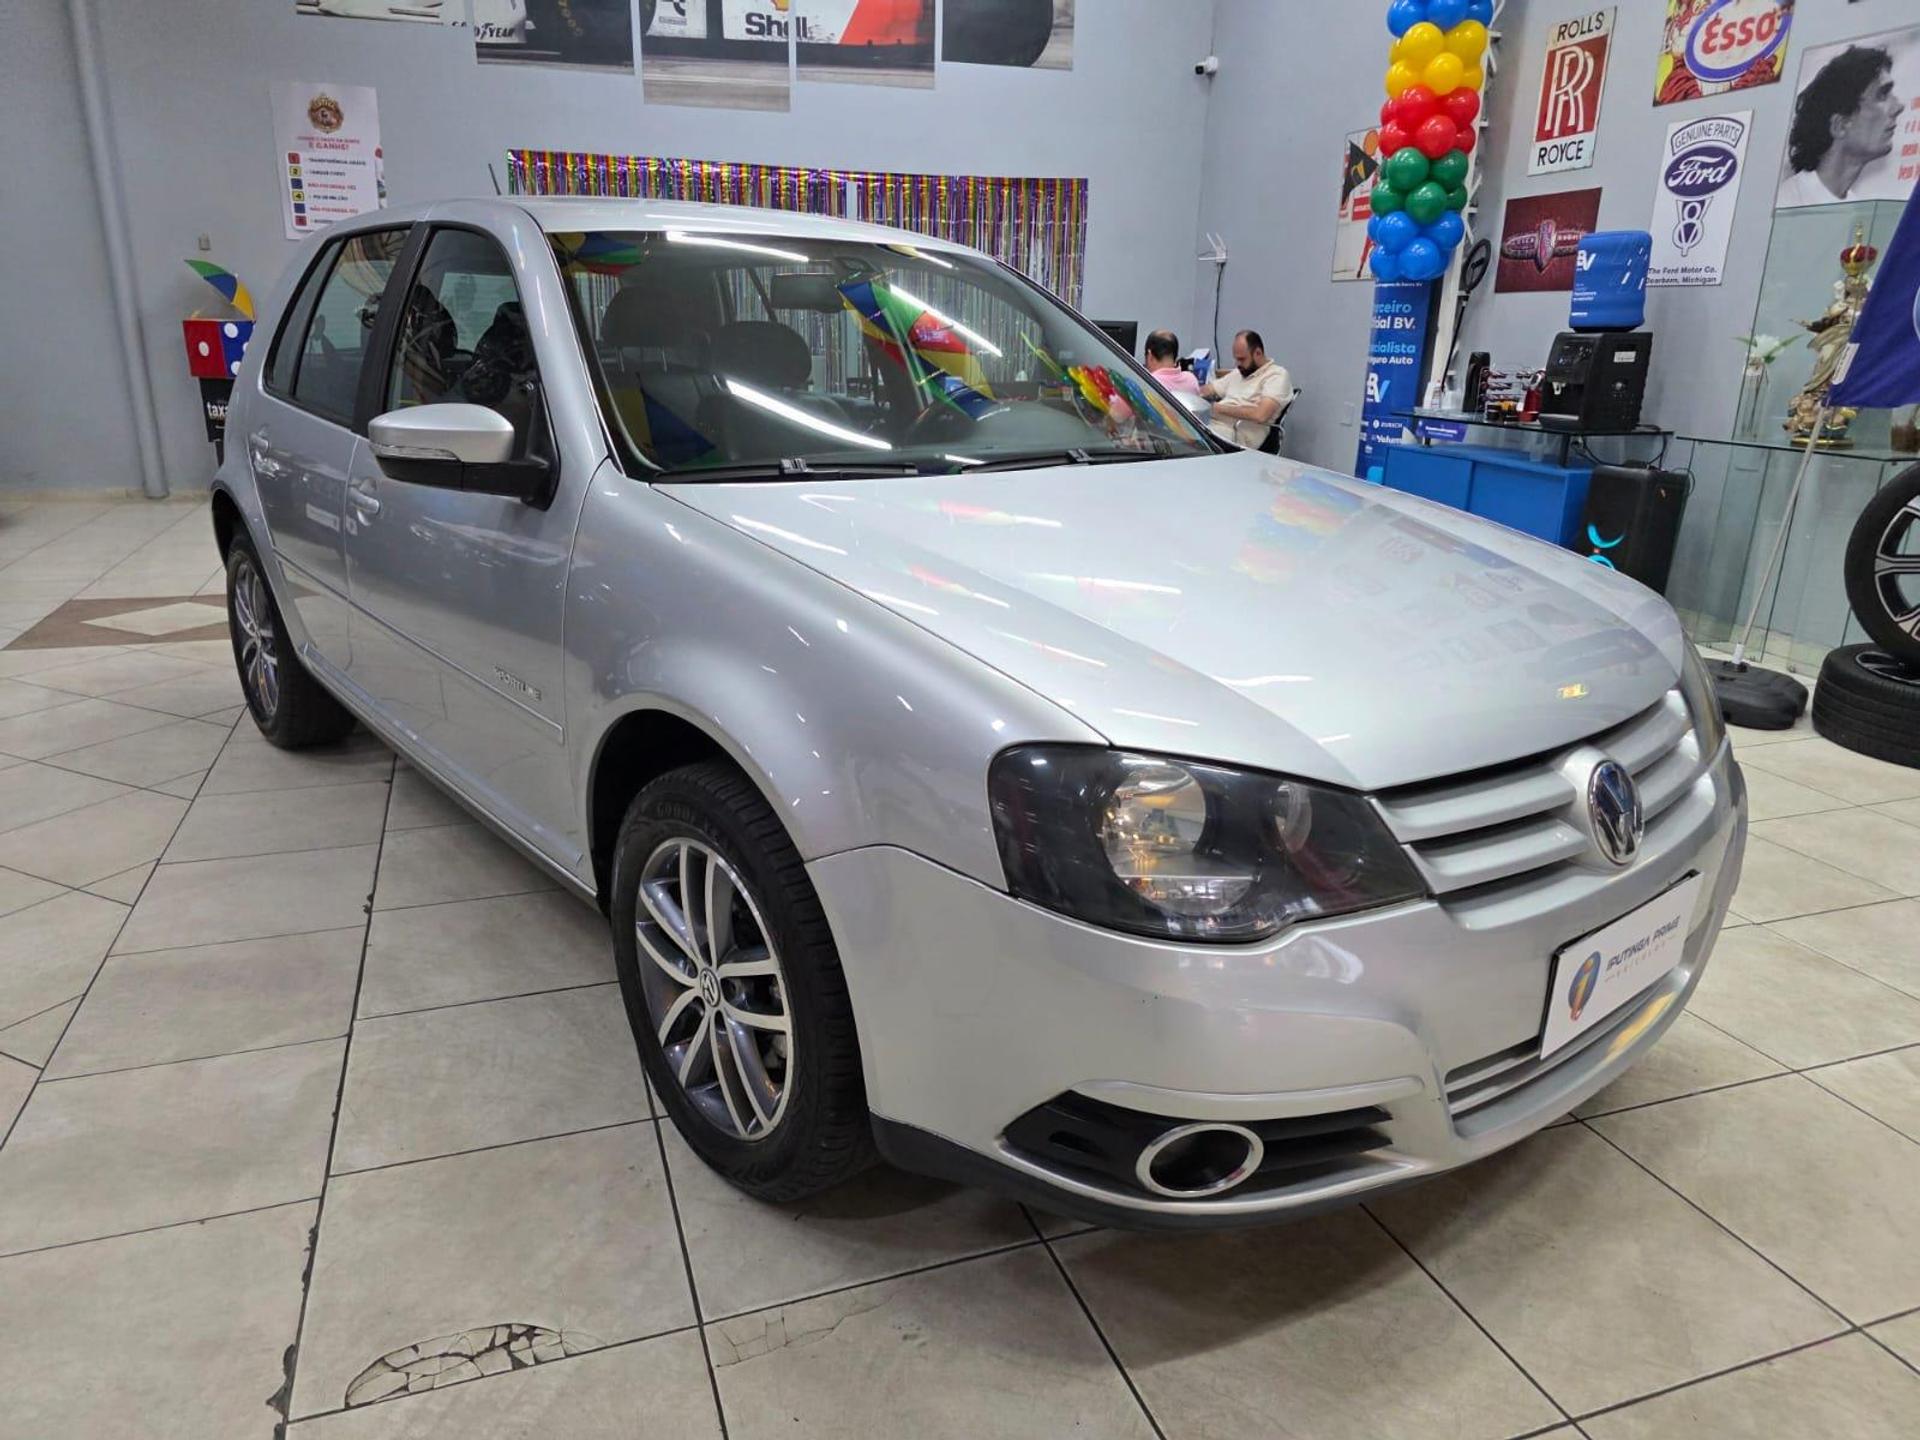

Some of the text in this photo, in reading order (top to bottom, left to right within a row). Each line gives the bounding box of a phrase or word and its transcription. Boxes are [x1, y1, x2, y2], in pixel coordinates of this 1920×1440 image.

[1557, 12, 1605, 42] ROLLS
[1675, 123, 1740, 148] GENUINE PARTS
[1537, 140, 1584, 167] ROYCE
[1668, 155, 1734, 187] Ford
[1663, 266, 1679, 274] Ford
[1682, 276, 1717, 285] Michigan
[1389, 356, 1414, 364] Auto
